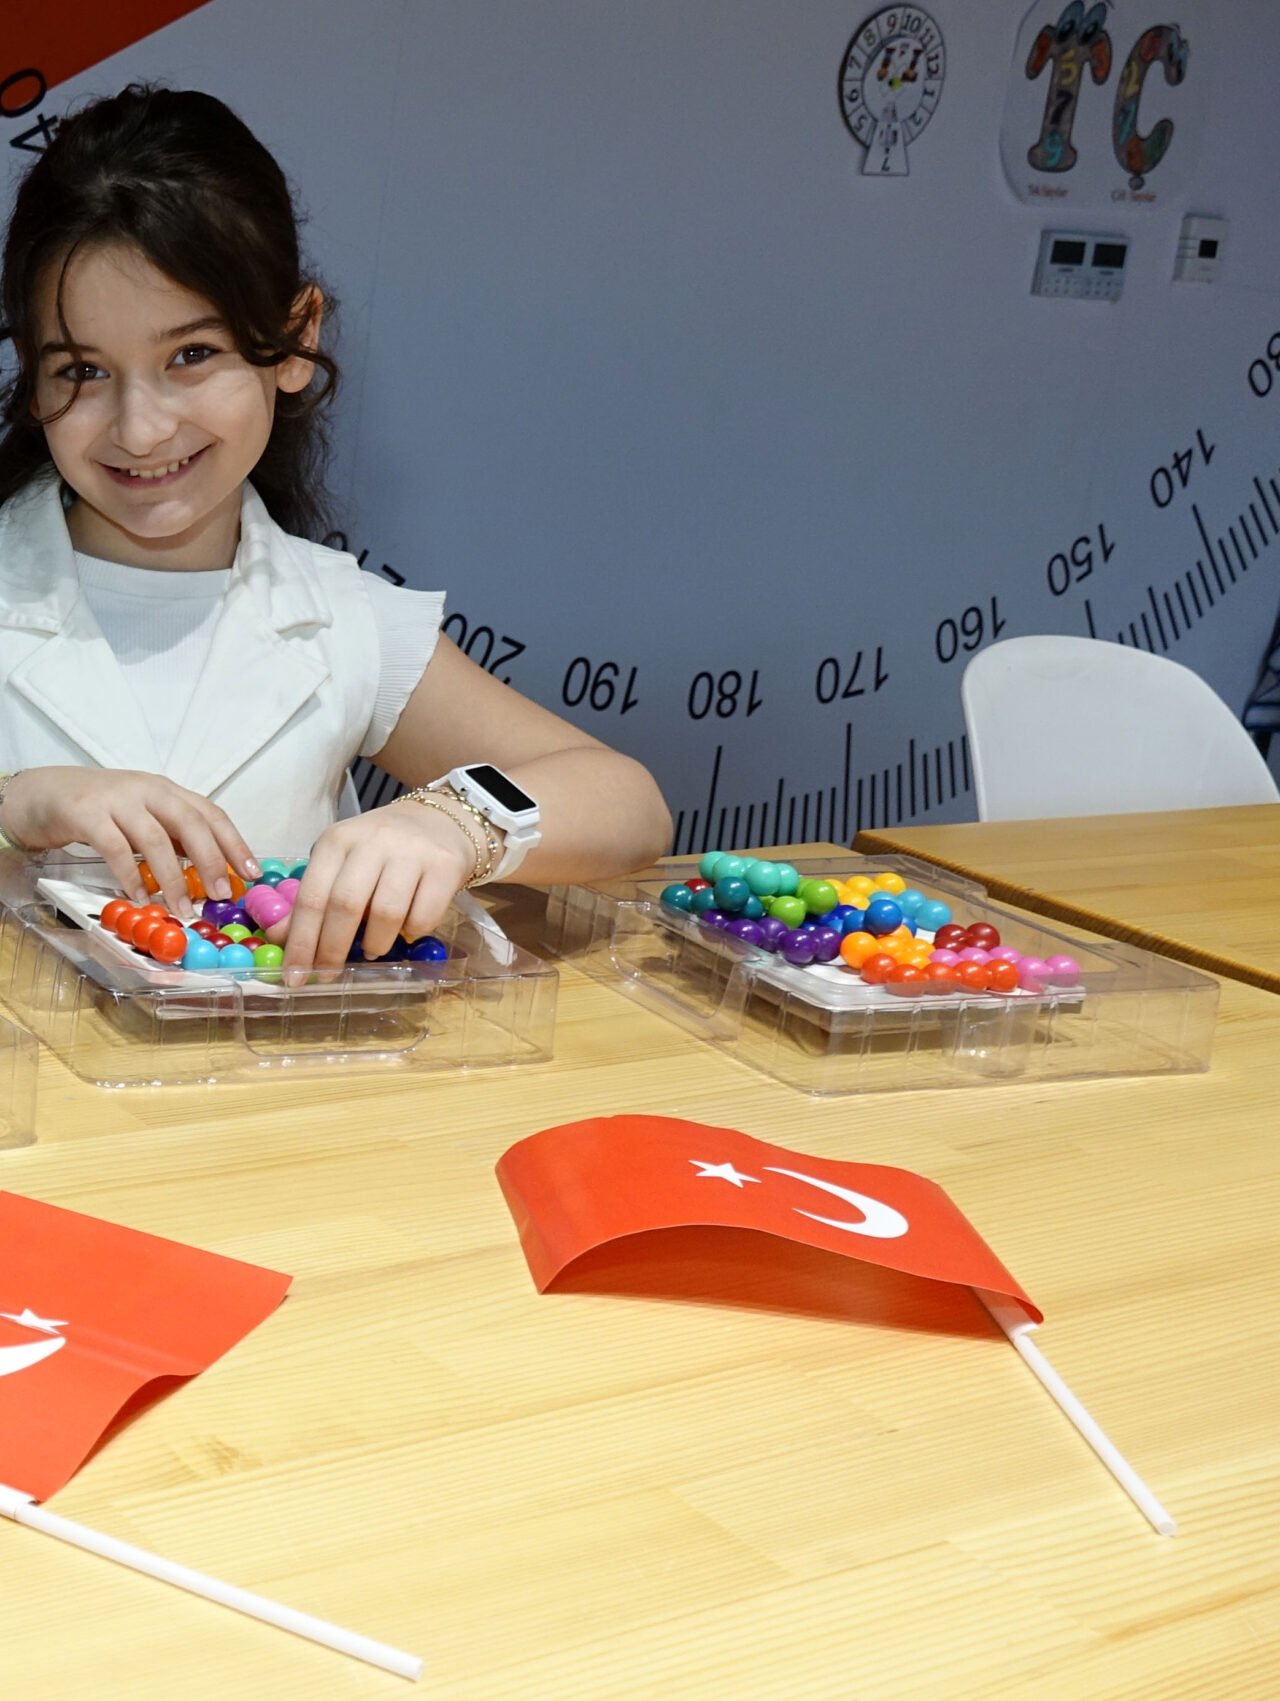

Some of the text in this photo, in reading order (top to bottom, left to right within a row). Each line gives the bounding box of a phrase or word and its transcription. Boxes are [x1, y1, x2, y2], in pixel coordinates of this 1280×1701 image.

[901, 13, 922, 33] 10
[1150, 429, 1215, 509] 140
[1047, 523, 1115, 597] 150
[935, 596, 1006, 664] 160
[561, 656, 639, 716] 190
[687, 669, 763, 721] 180
[815, 646, 889, 705] 170
